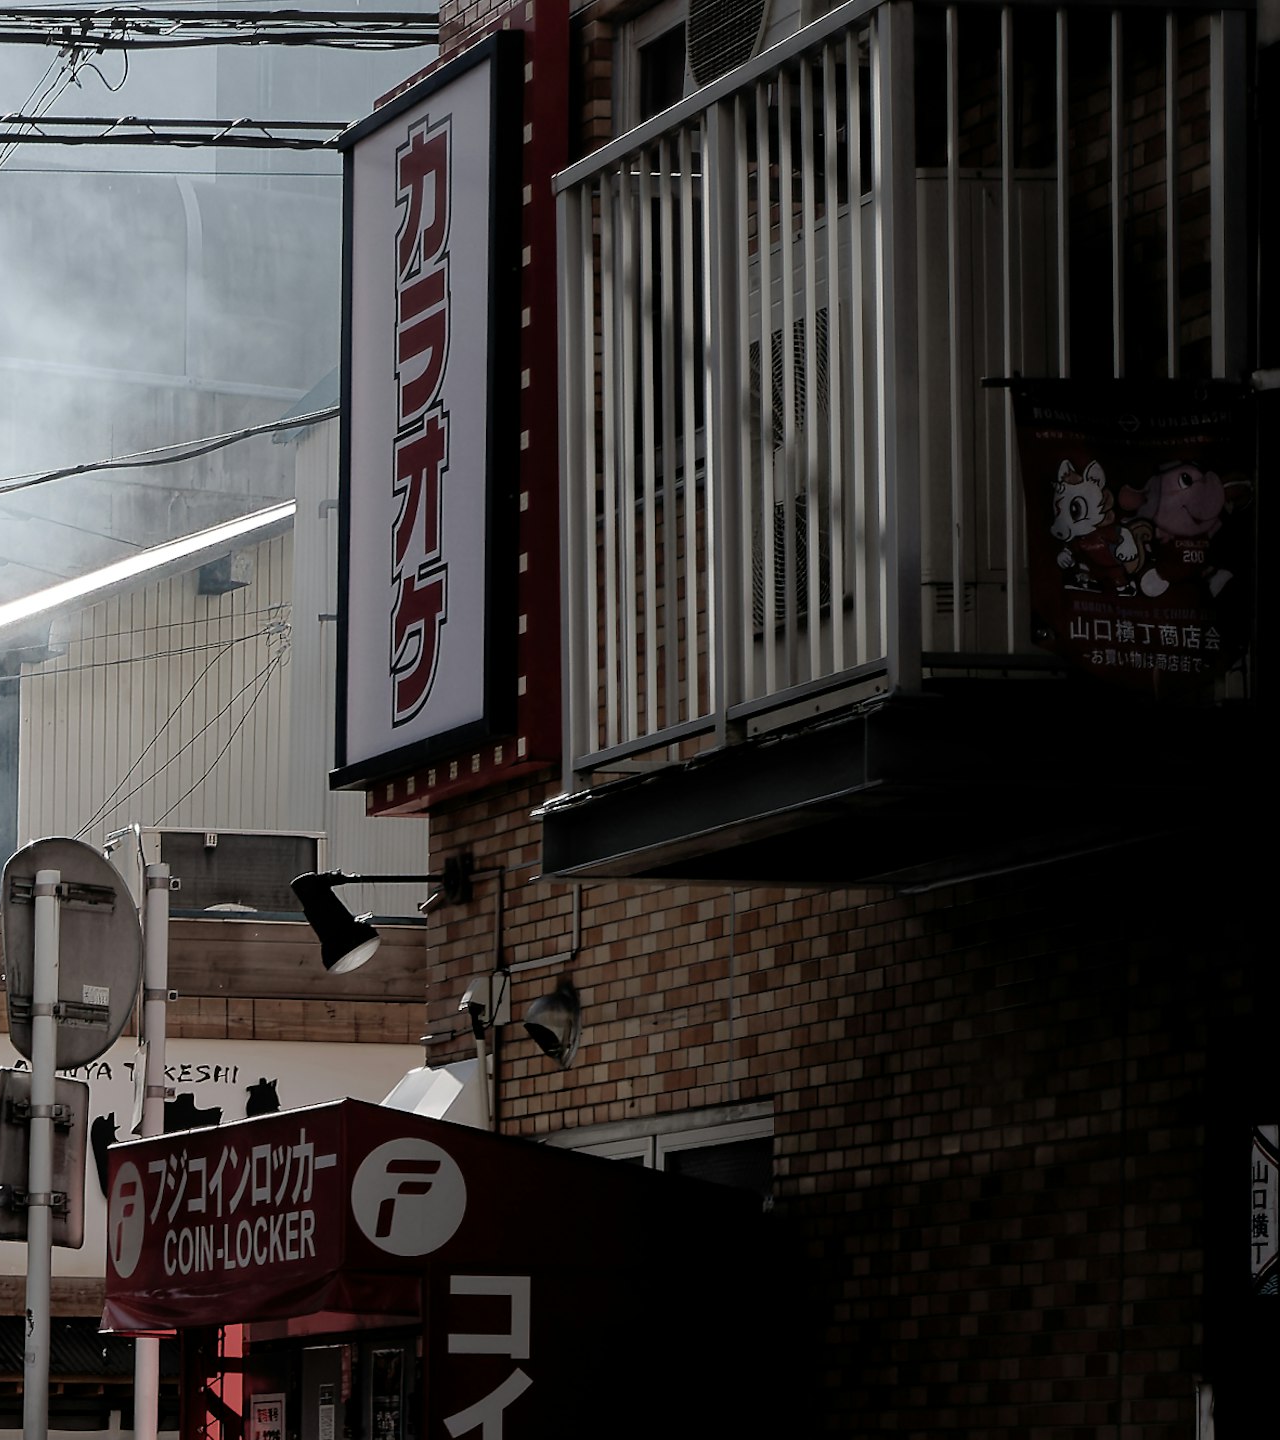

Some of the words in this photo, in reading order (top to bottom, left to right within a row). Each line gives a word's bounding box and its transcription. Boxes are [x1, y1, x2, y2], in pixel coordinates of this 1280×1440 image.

[389, 112, 452, 730] カラオケ
[1068, 615, 1222, 653] 山口横丁商店会
[147, 1127, 338, 1226] フジコインロッカー
[1252, 1160, 1269, 1265] 山口横丁
[163, 1208, 317, 1278] COIN-LOCKER
